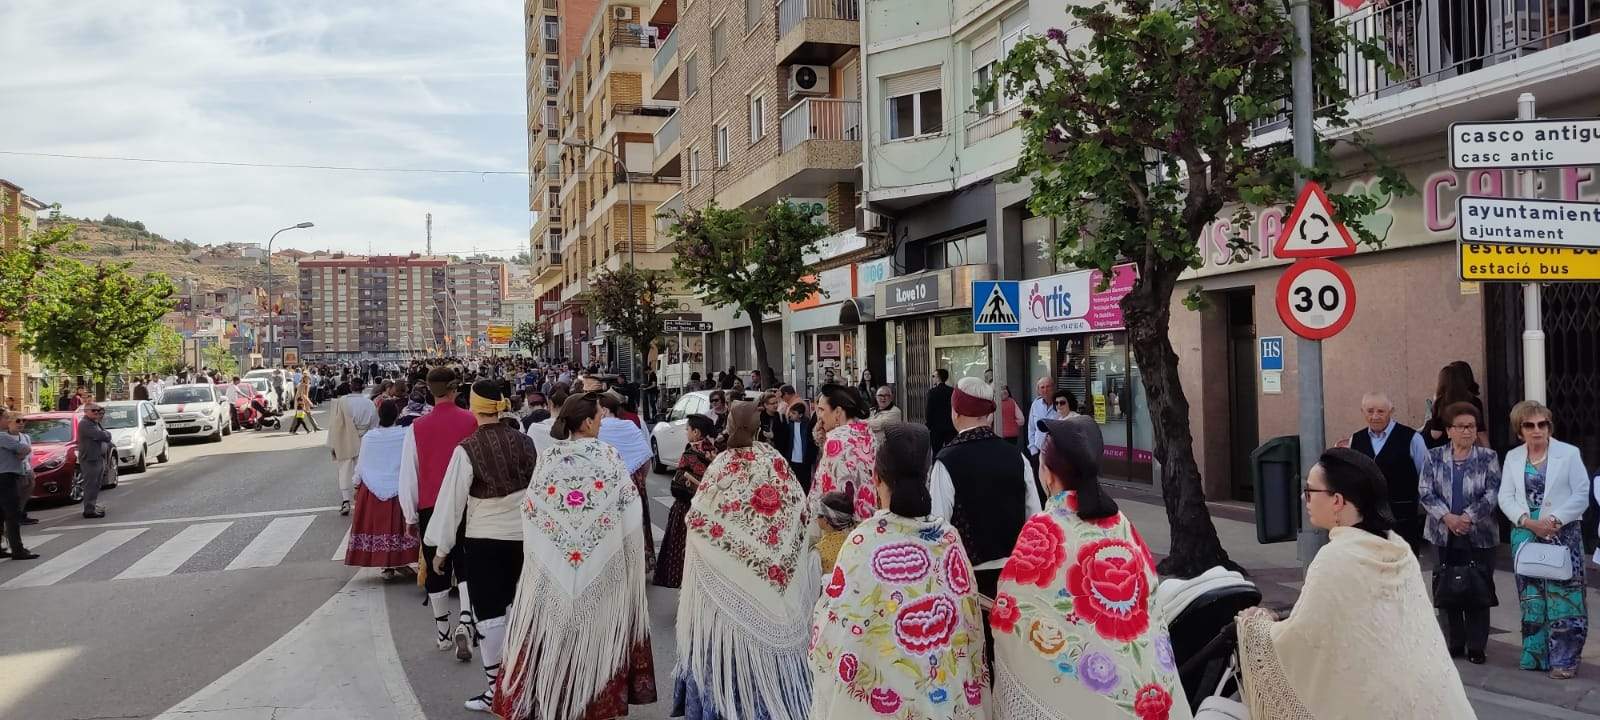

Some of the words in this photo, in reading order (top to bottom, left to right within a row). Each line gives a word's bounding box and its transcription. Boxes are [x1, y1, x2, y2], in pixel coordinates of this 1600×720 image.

[1461, 130, 1524, 143] casco
[1461, 152, 1501, 163] casc
[1511, 149, 1554, 162] antic
[1469, 225, 1564, 240] ajuntament
[1469, 262, 1530, 274] estació
[1540, 263, 1569, 274] bus
[896, 283, 926, 302] iLove10
[1294, 285, 1339, 312] 30
[1032, 284, 1071, 320] artis
[1263, 341, 1280, 357] HS
